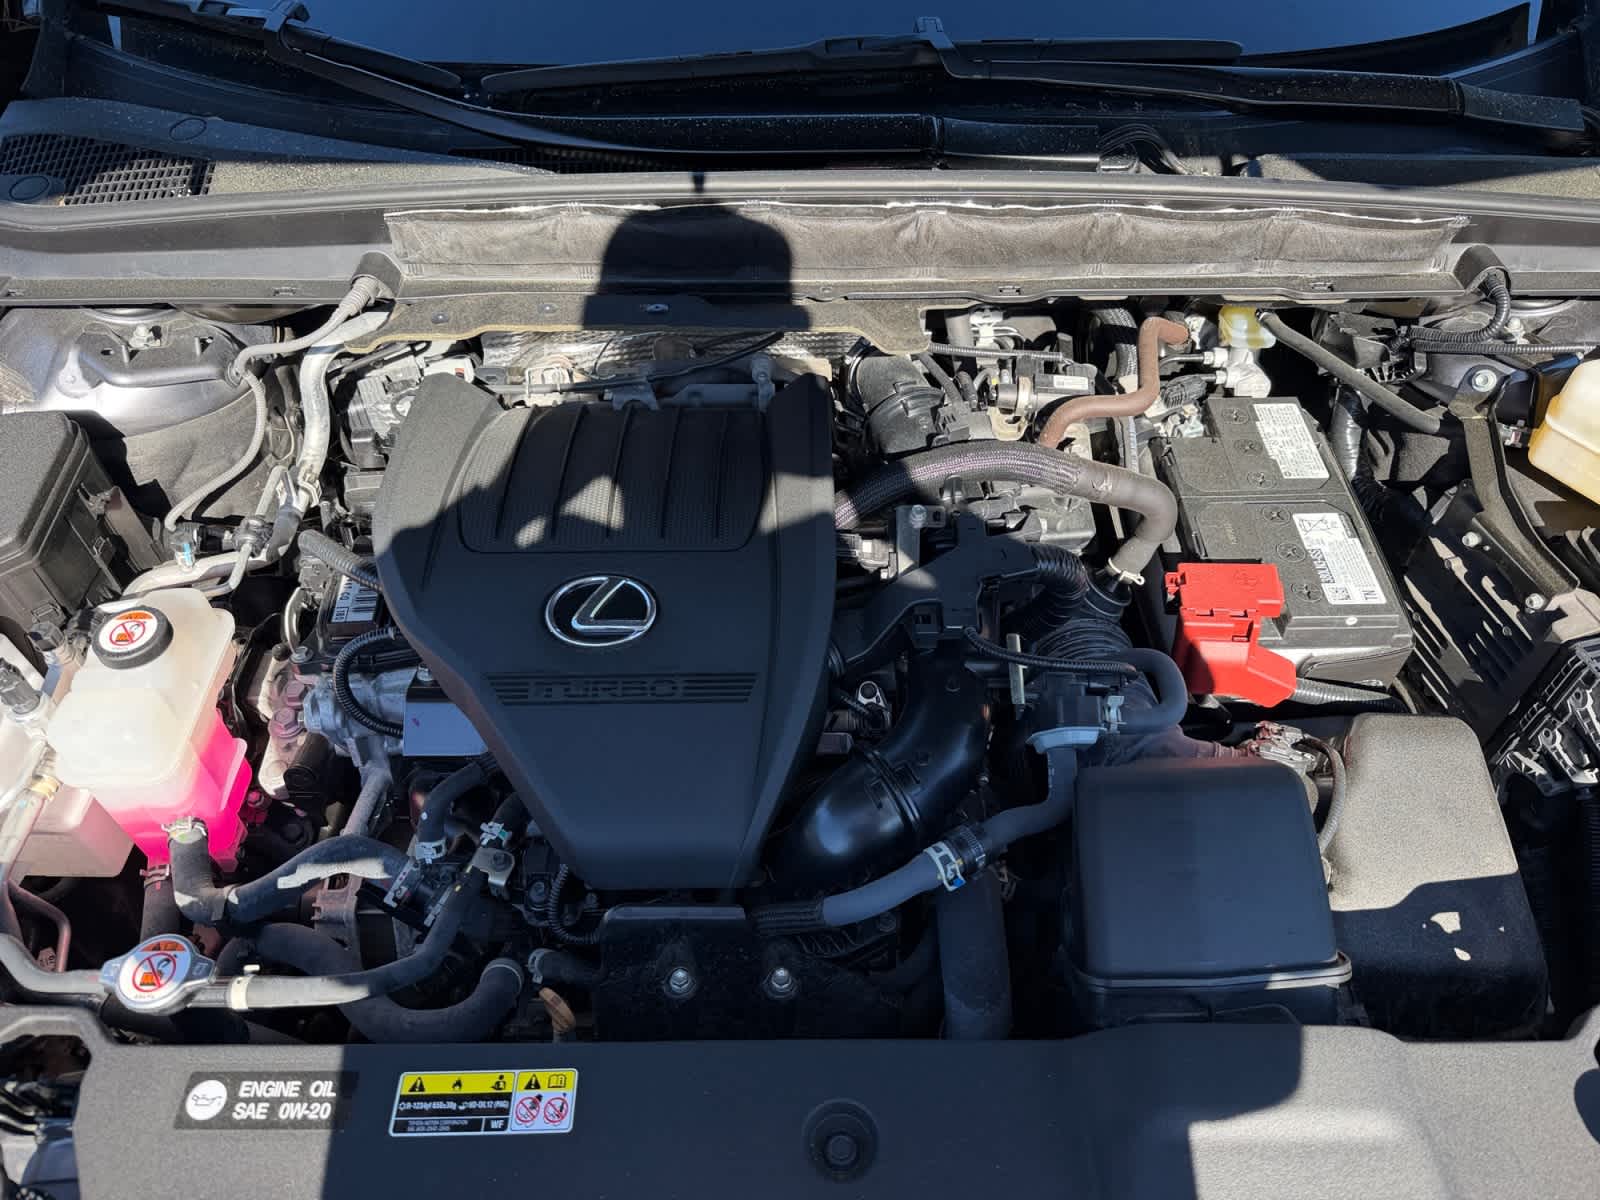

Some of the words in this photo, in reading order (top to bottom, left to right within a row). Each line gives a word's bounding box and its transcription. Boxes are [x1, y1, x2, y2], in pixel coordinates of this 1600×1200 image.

[533, 680, 678, 698] TURBO
[238, 1080, 302, 1097] ENGINE
[309, 1080, 336, 1097] OIL
[232, 1102, 270, 1120] SAE
[278, 1102, 332, 1120] 0W-20
[490, 1119, 504, 1129] WF
